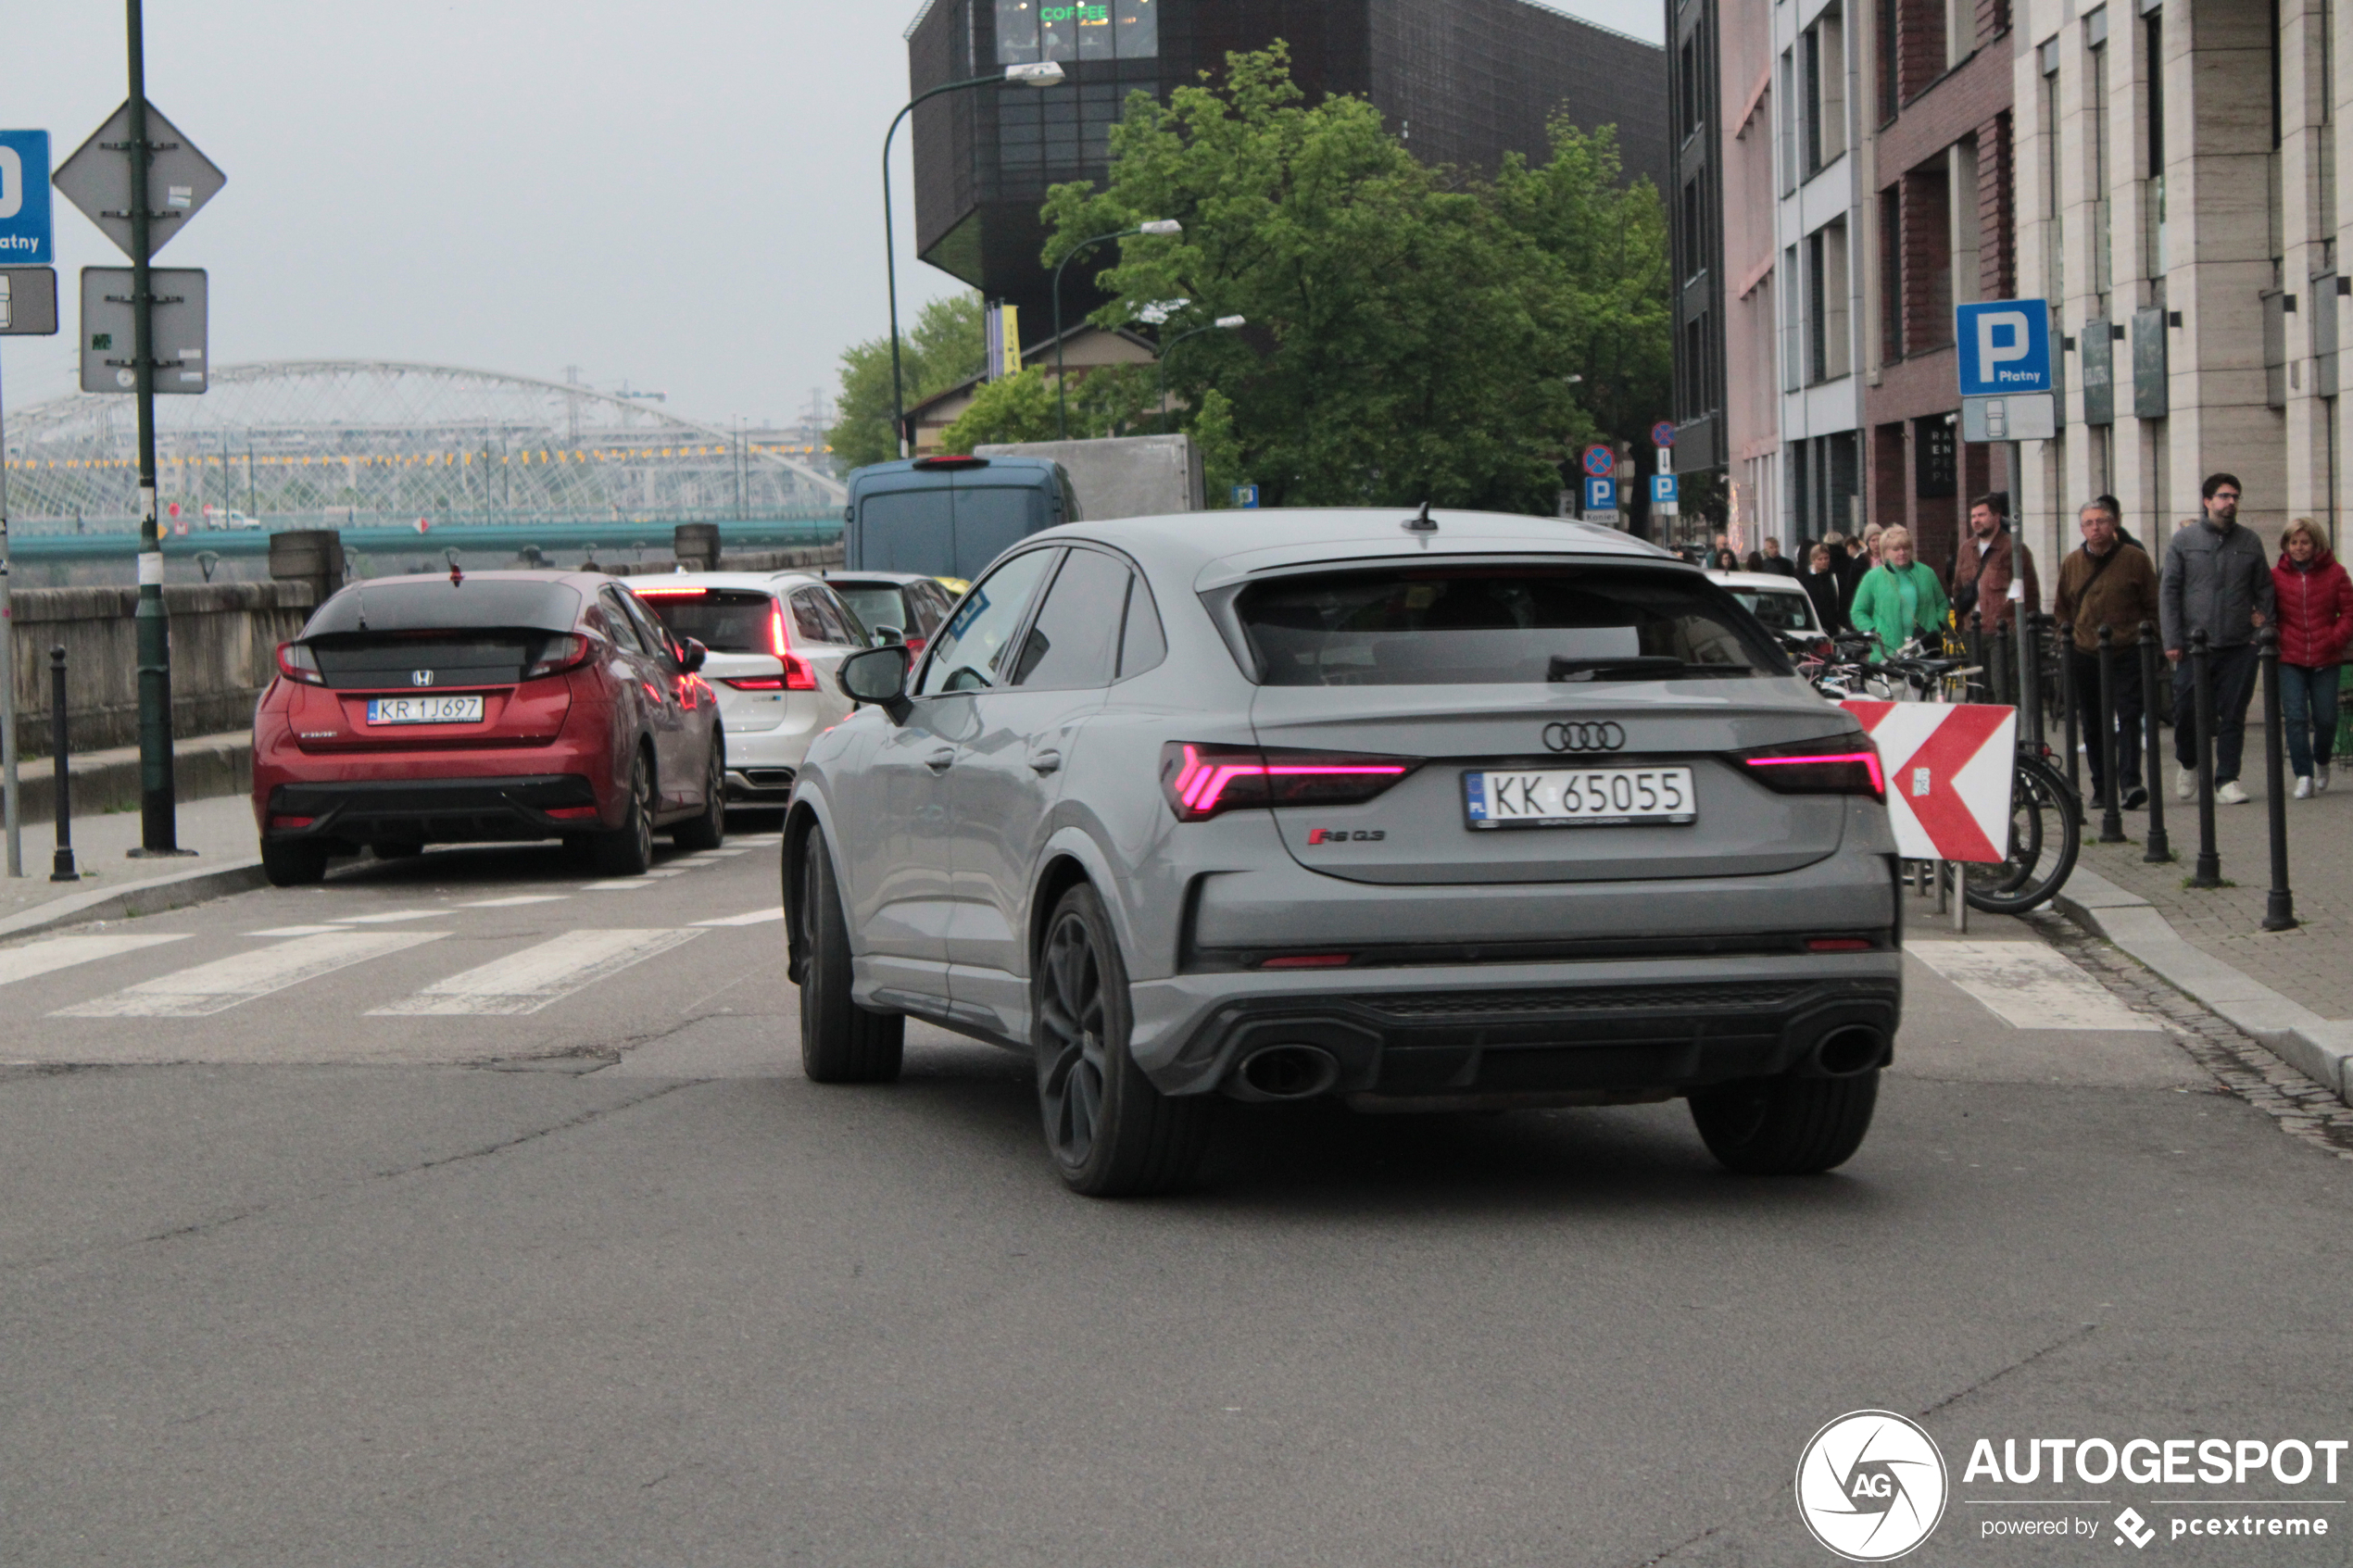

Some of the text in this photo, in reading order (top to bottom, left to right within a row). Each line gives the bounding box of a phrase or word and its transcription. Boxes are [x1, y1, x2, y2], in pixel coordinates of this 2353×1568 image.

[1040, 5, 1107, 20] COFFEE
[1978, 311, 2030, 383] P
[1999, 370, 2041, 383] Płatny
[1592, 481, 1610, 506] P
[1657, 478, 1672, 498] P
[381, 698, 477, 719] KR 1J697
[1494, 773, 1681, 815] KK 65055
[1469, 801, 1486, 813] PL
[1353, 830, 1386, 841] Q3
